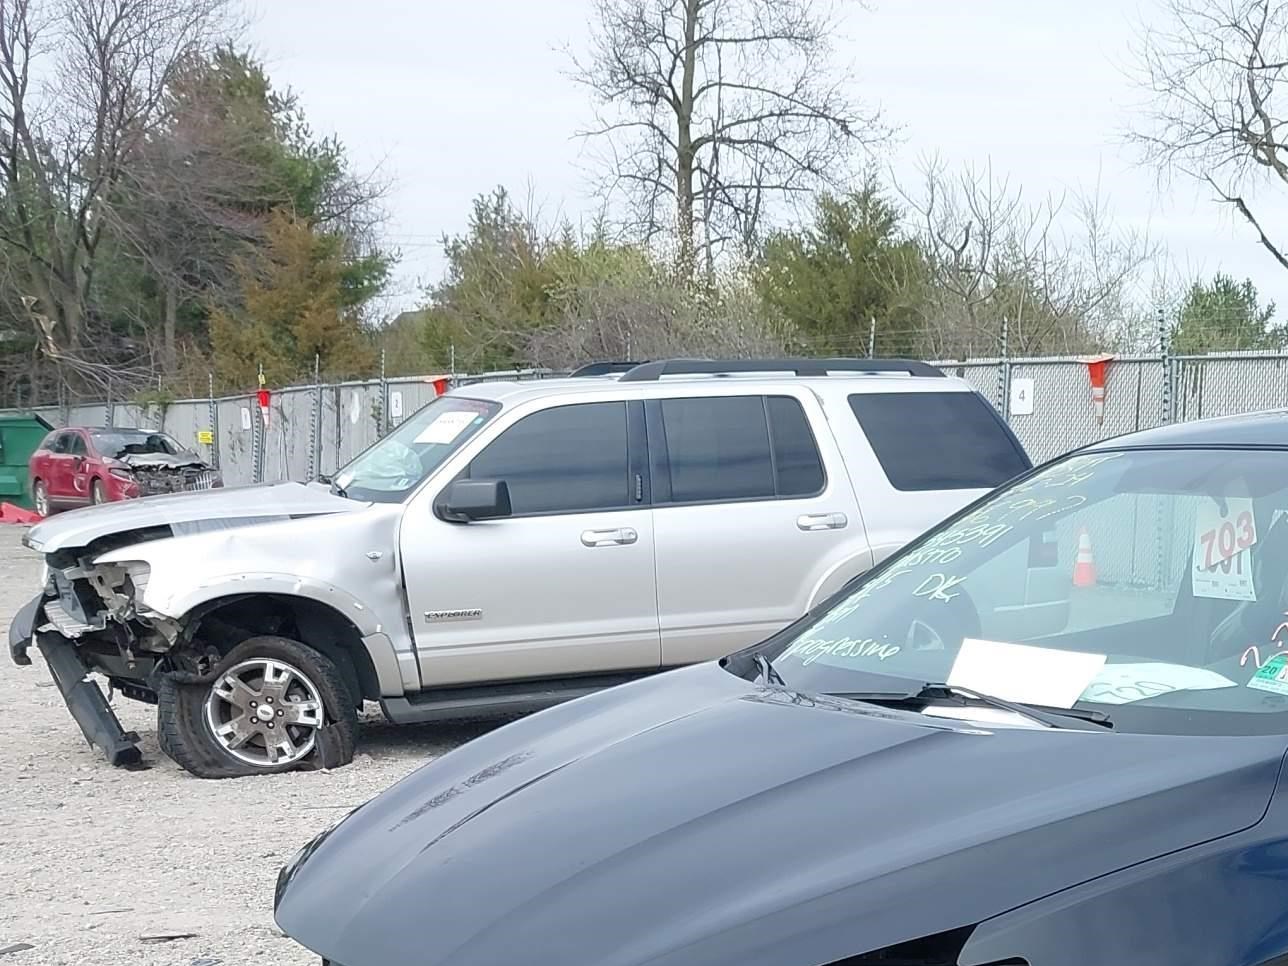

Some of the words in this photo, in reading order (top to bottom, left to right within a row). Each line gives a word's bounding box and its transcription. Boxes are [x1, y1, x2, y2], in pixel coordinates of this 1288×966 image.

[1018, 389, 1026, 402] 4
[1200, 511, 1255, 570] 703
[425, 610, 481, 619] EXPLORER
